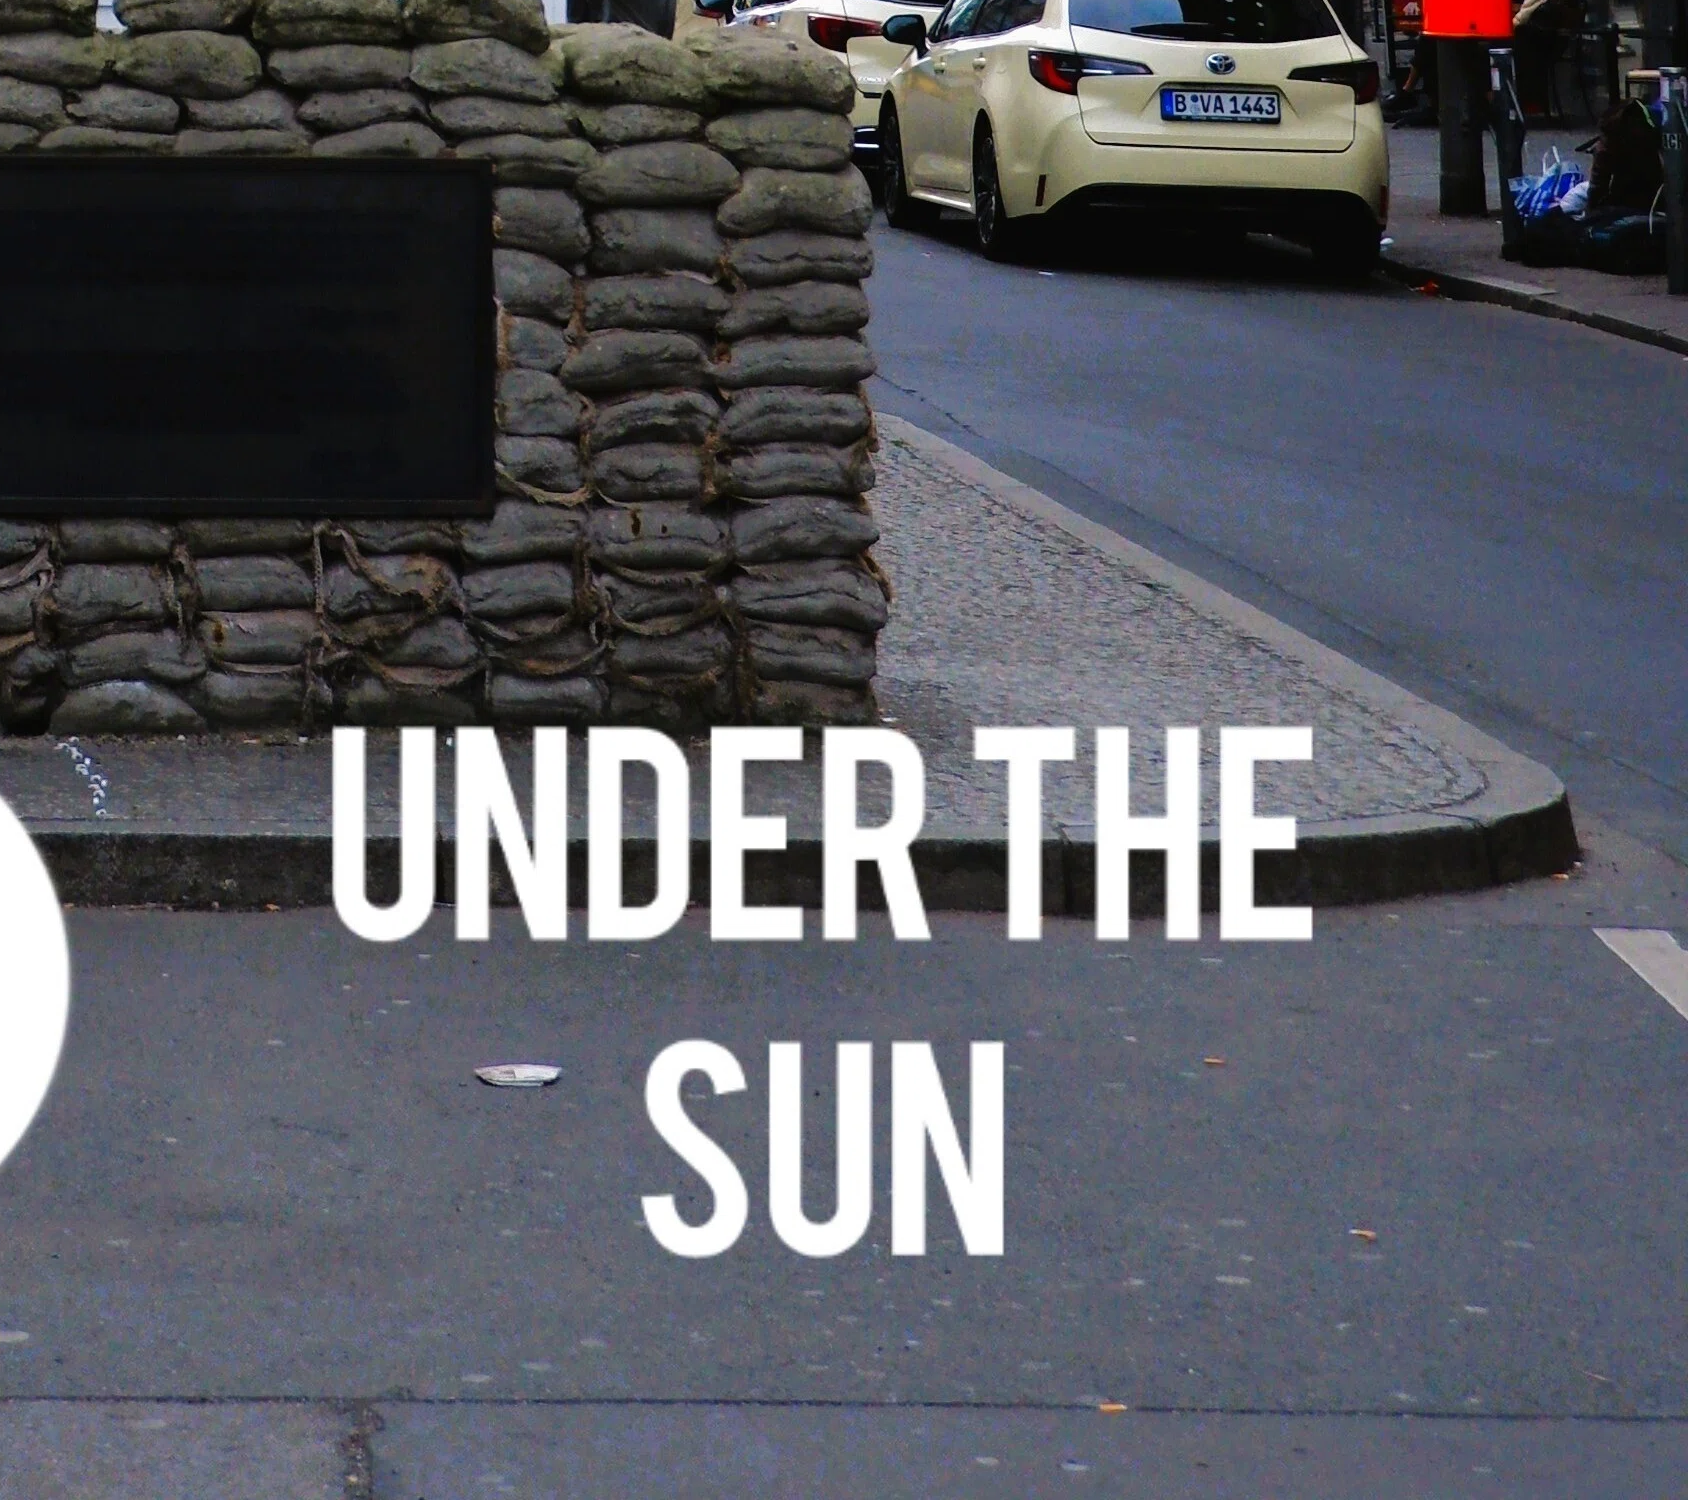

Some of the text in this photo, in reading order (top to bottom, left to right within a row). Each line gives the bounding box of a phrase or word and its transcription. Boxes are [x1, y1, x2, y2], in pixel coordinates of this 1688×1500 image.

[1174, 93, 1277, 116] B VA 1443
